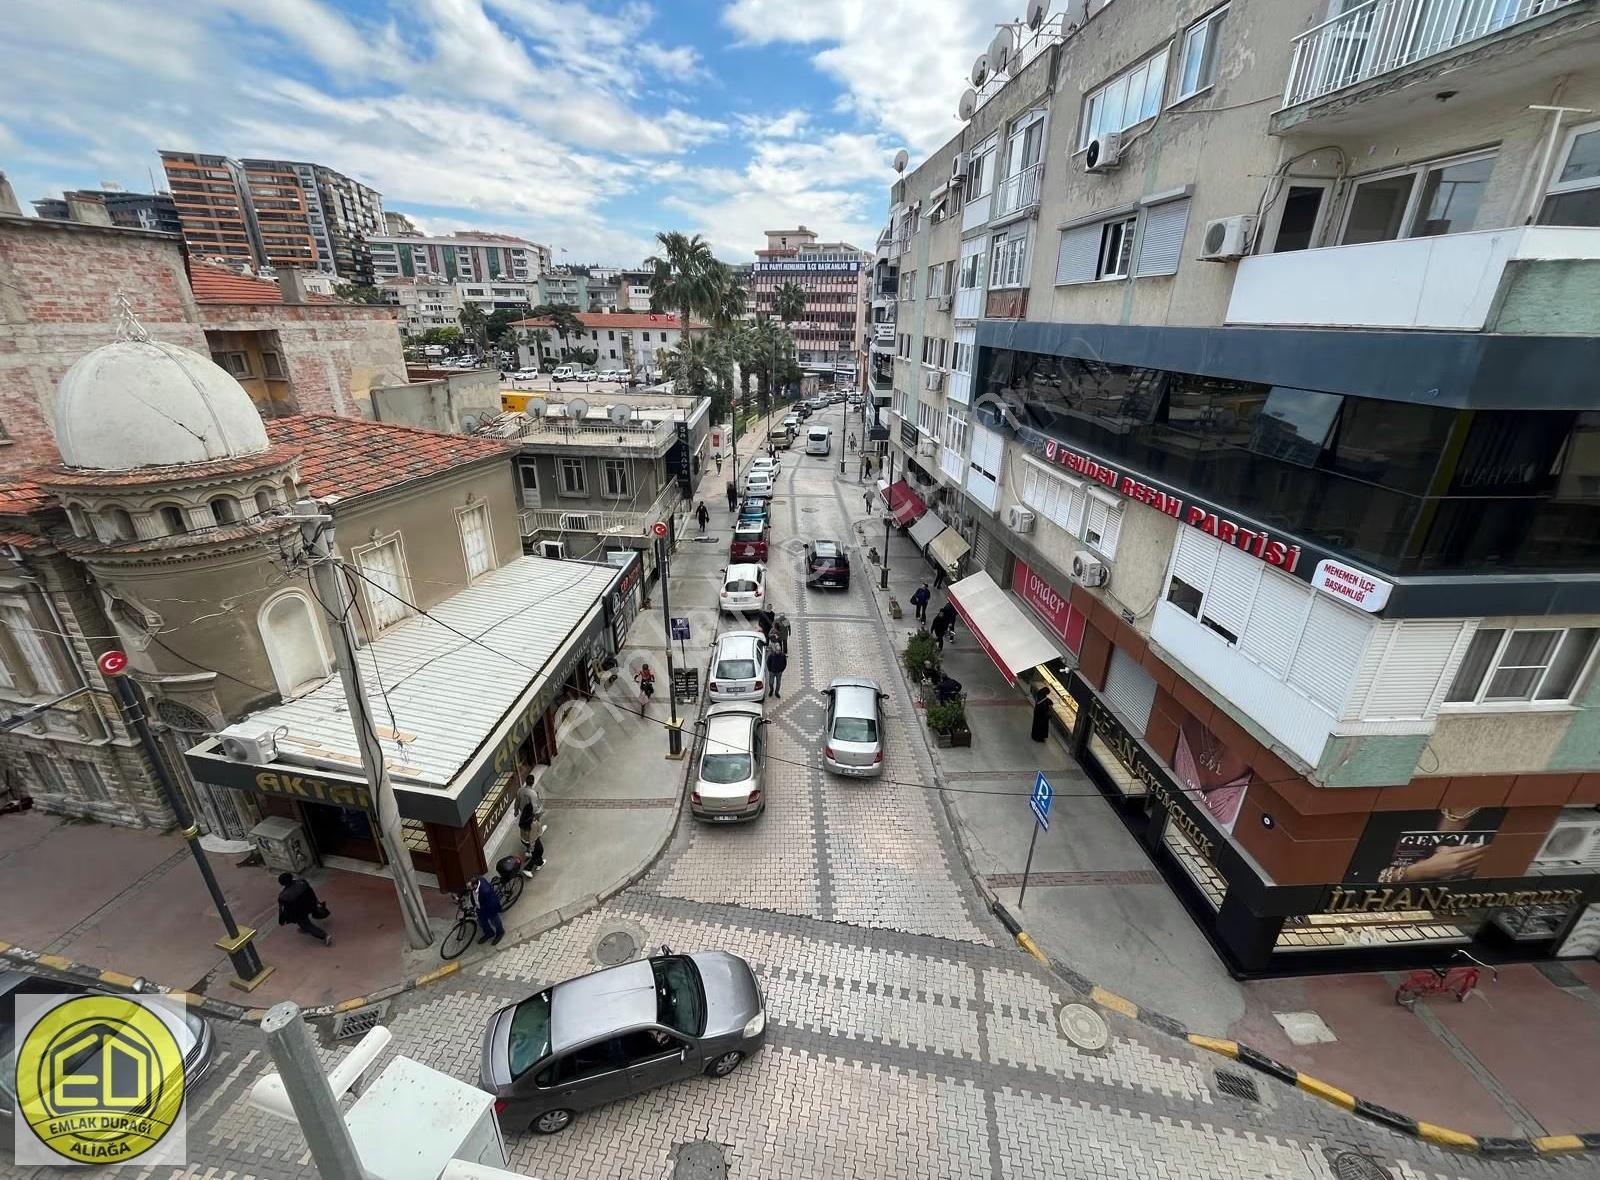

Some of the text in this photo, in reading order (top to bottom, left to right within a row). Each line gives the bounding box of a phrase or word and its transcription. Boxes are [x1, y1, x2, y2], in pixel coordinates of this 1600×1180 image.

[1057, 448, 1301, 573] YENİDEN REFAH PARTİSİ
[1323, 564, 1376, 594] MENEMEN İLÇE
[1324, 577, 1365, 603] BAŞKANLIĞI
[1323, 885, 1449, 914] İLHAN
